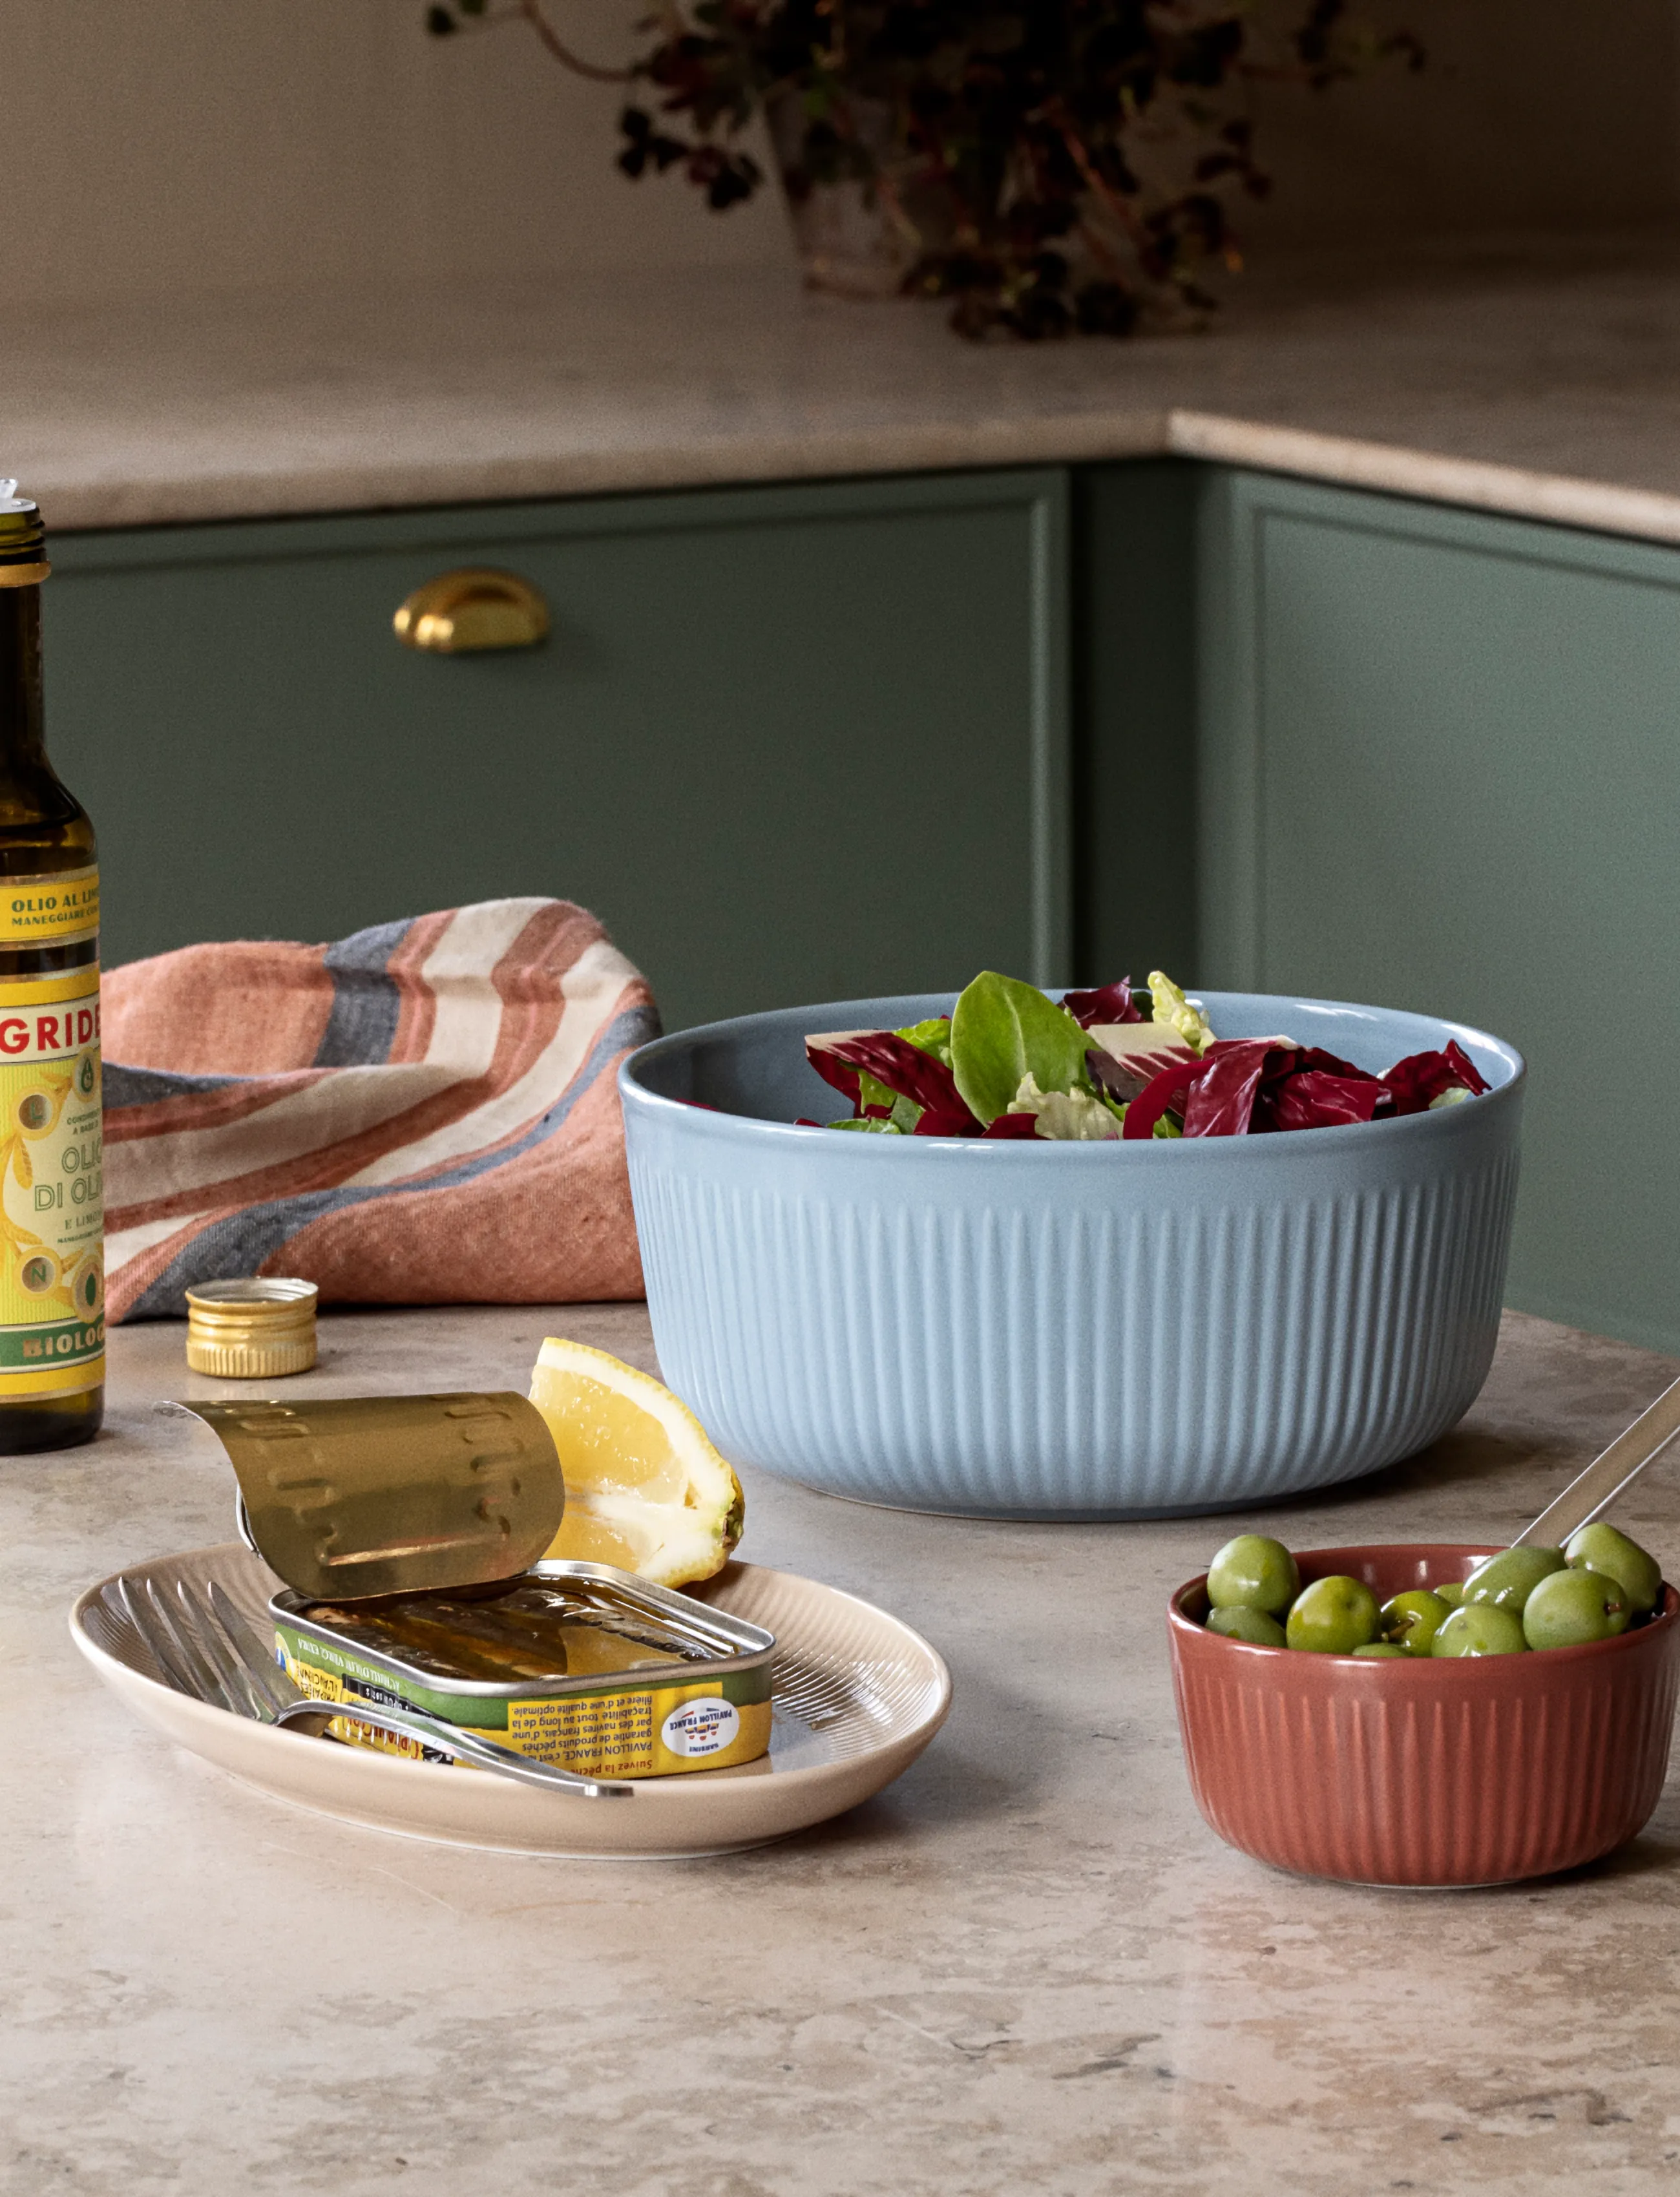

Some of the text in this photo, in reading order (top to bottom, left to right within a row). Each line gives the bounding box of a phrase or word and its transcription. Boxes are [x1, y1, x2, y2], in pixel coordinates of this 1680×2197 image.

[12, 897, 57, 912] OLIO
[62, 893, 78, 908] AL
[12, 910, 84, 925] MANEGGIARE
[35, 1183, 63, 1212] DI
[65, 1219, 72, 1230] E
[31, 1265, 46, 1284] N
[590, 1701, 614, 1709] d'une
[627, 1696, 652, 1705] filière
[512, 1705, 555, 1717] optimale.
[558, 1701, 587, 1713] qualité
[602, 1705, 652, 1719] traçabilité
[540, 1718, 561, 1729] long
[578, 1714, 598, 1723] tout
[636, 1716, 652, 1728] par
[669, 1709, 732, 1730] PAVILLON FRANCE
[583, 1722, 616, 1732] navires
[619, 1721, 633, 1730] des
[512, 1732, 540, 1740] d'une
[600, 1735, 611, 1743] de
[614, 1728, 651, 1741] garantie
[558, 1736, 597, 1749] produits
[605, 1741, 652, 1755] PAVILLON
[605, 1765, 614, 1774] la
[618, 1760, 653, 1771] Suivez
